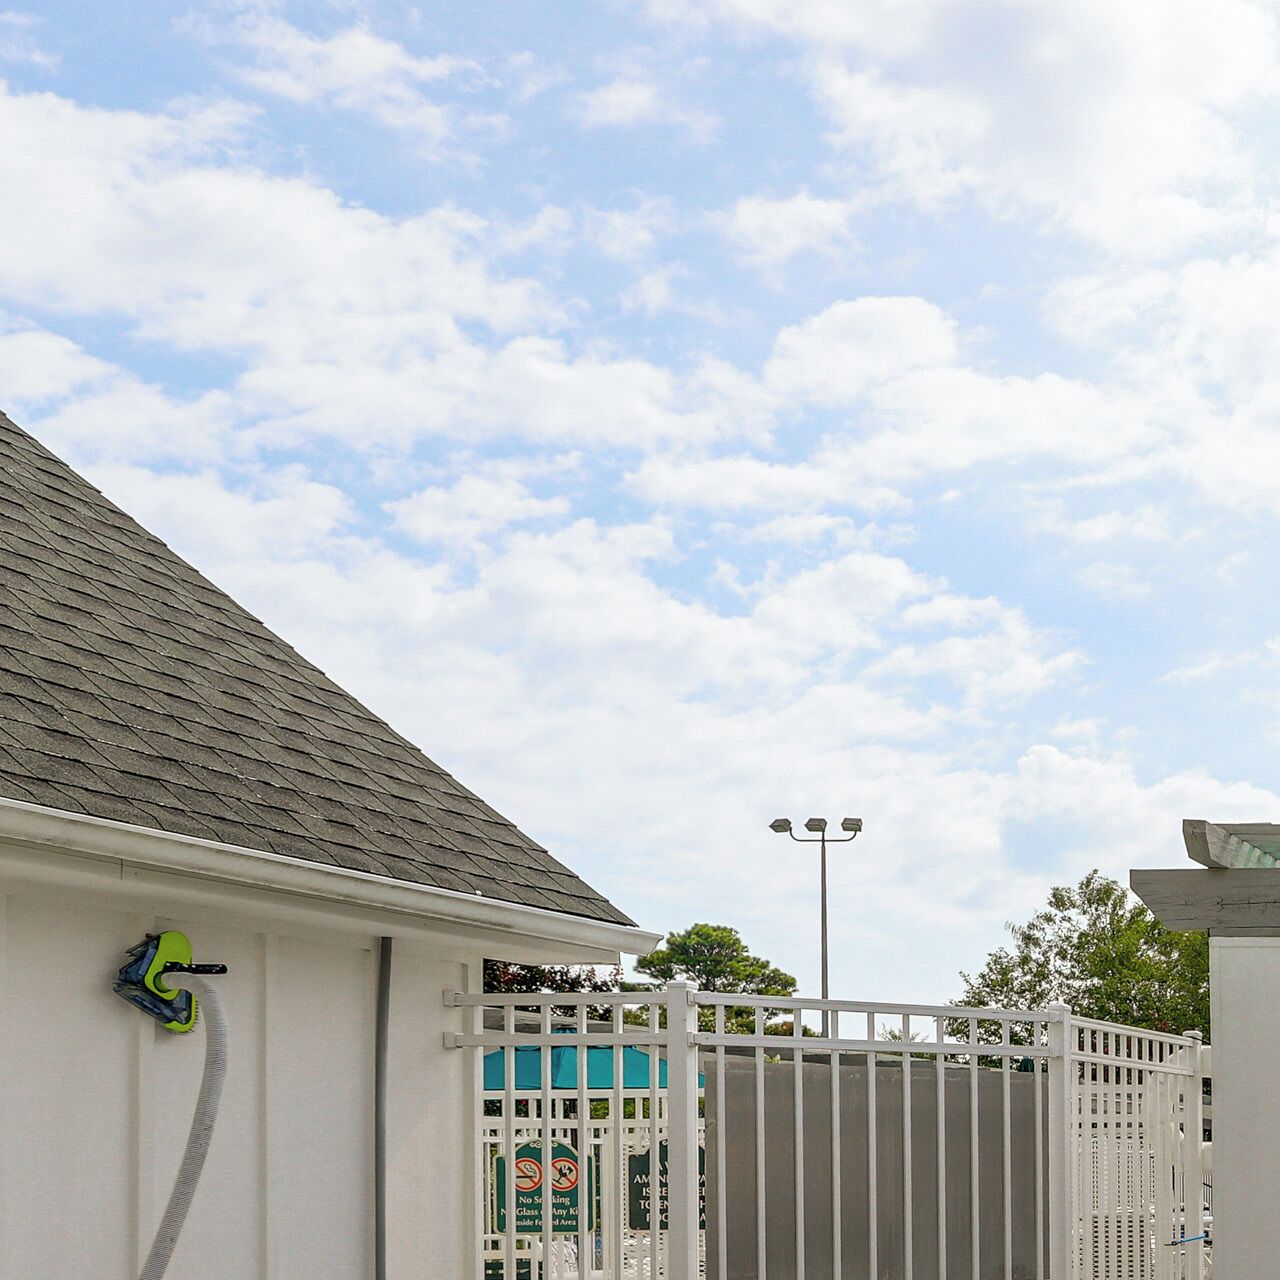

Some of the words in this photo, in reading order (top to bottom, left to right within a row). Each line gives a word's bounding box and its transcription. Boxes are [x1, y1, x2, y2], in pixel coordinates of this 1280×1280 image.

[519, 1196, 532, 1204] No
[534, 1196, 571, 1206] Sking
[516, 1207, 539, 1216] Glass
